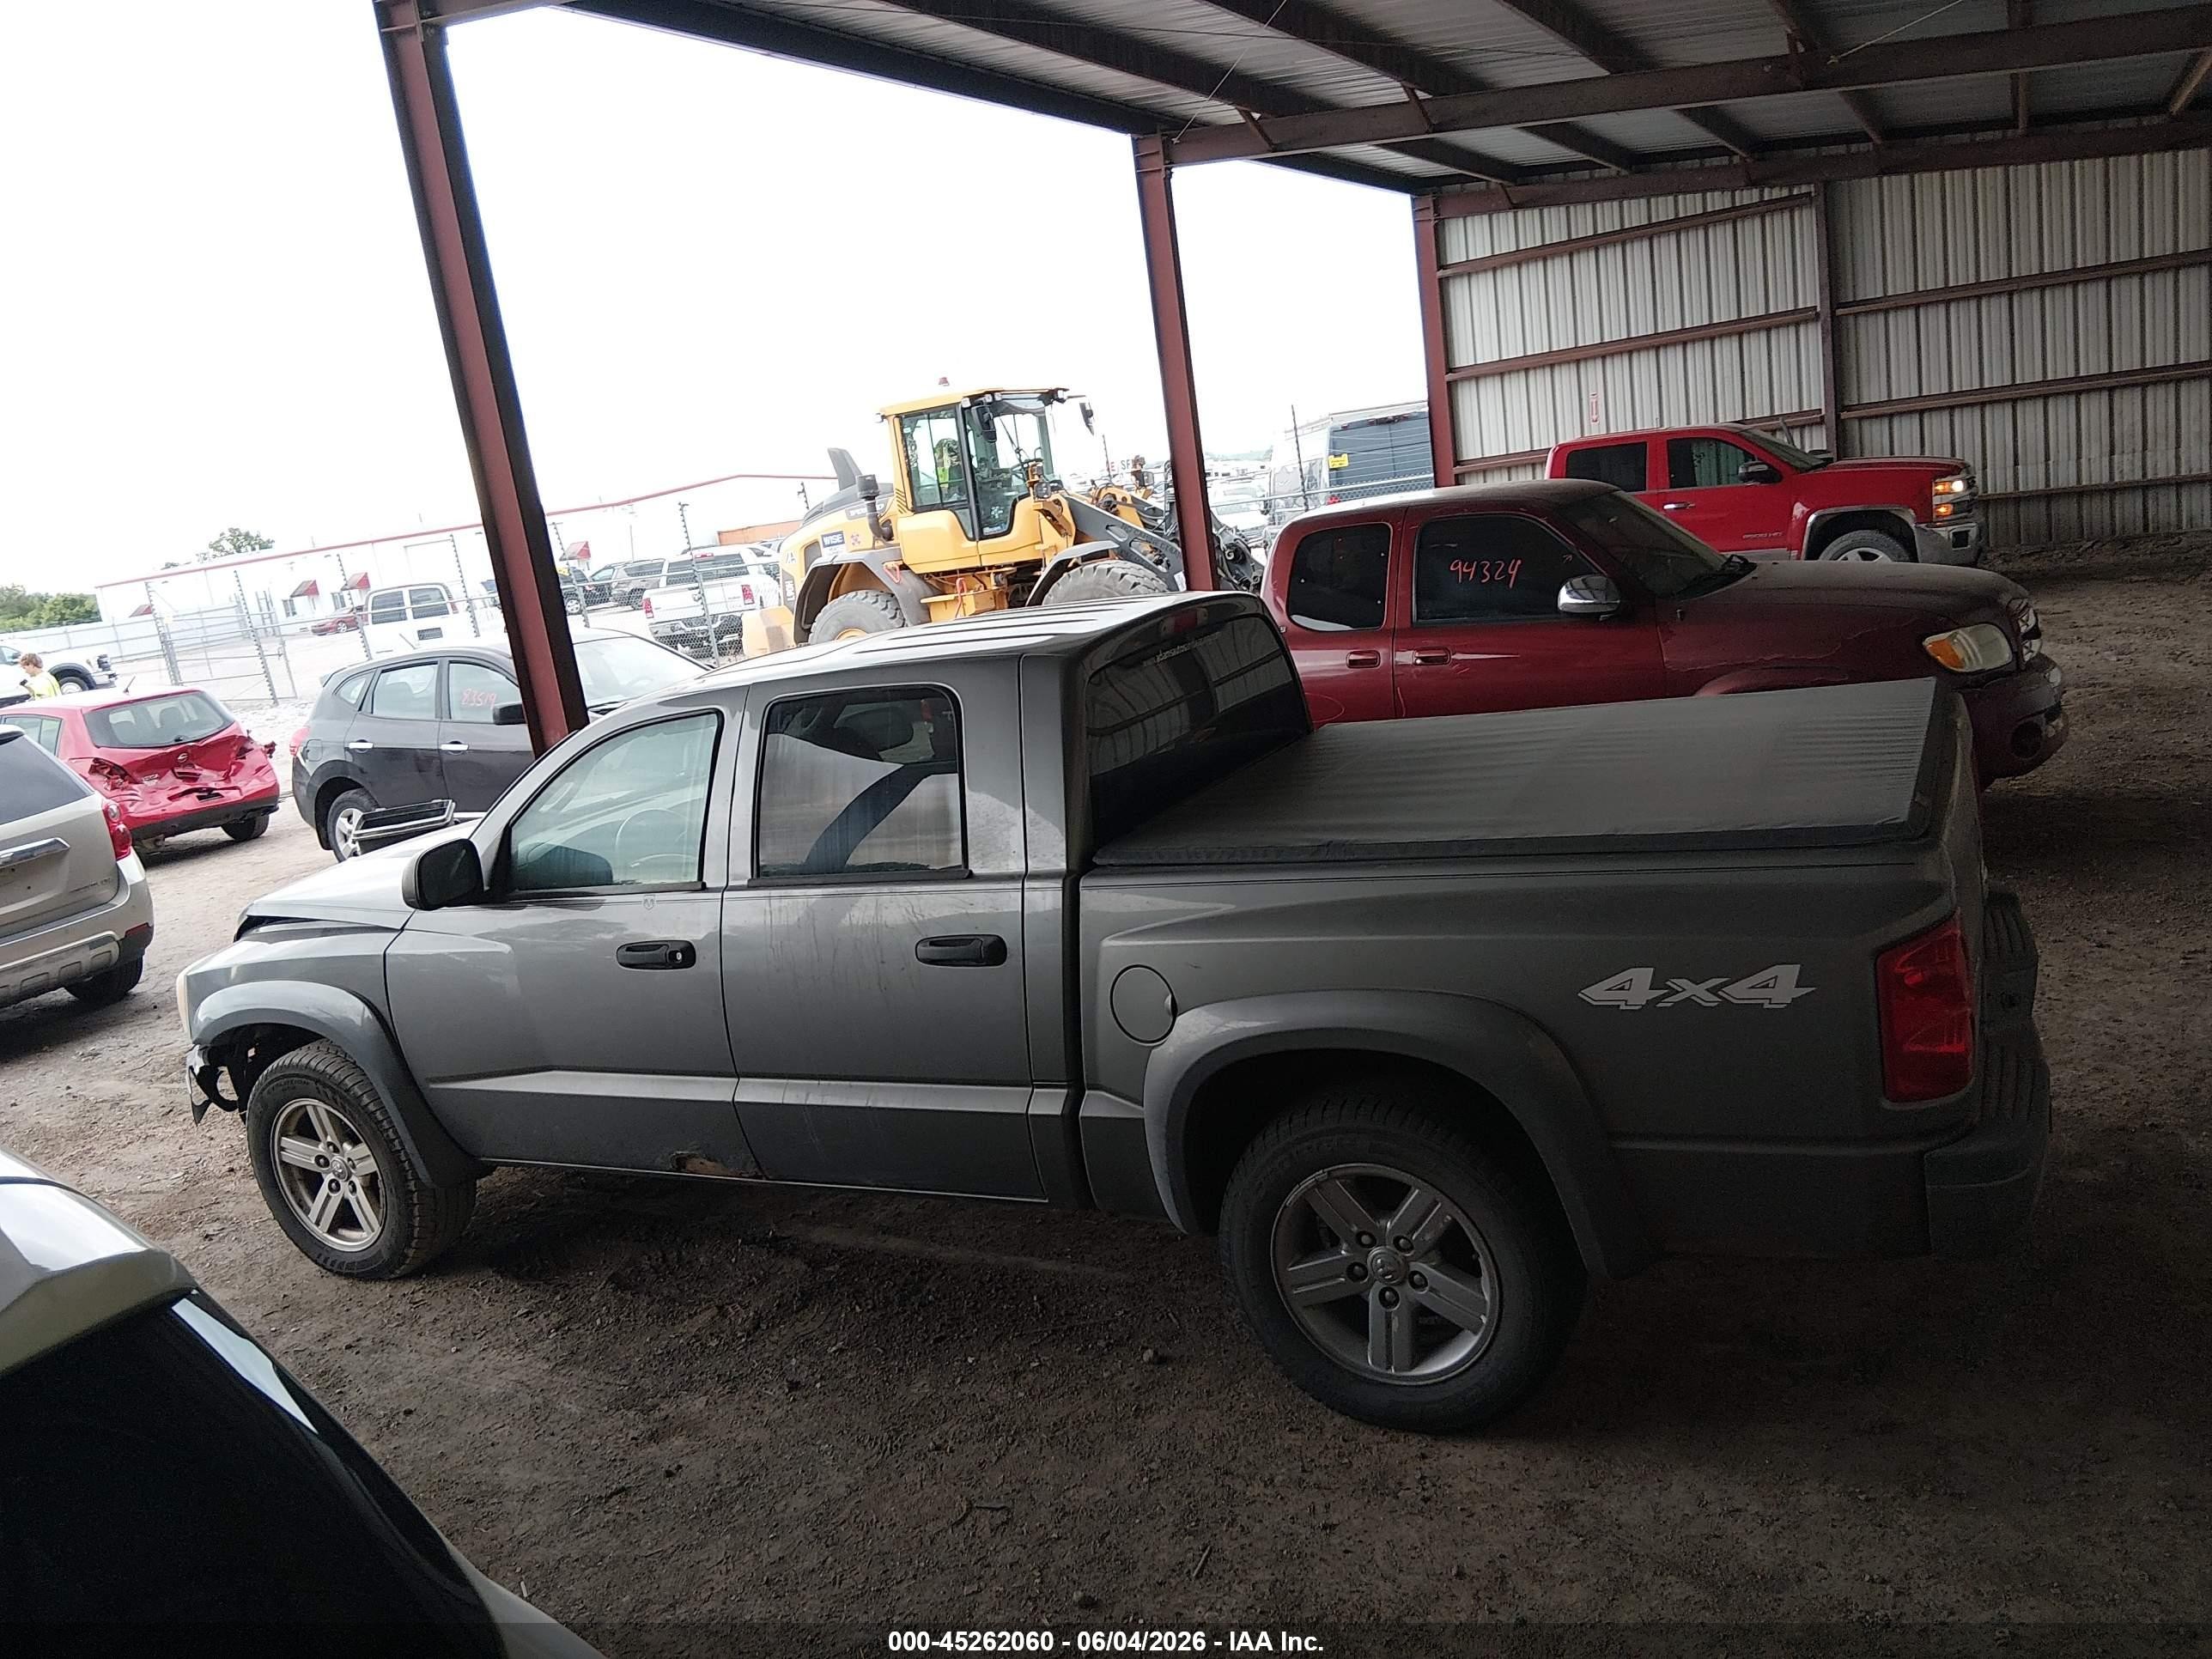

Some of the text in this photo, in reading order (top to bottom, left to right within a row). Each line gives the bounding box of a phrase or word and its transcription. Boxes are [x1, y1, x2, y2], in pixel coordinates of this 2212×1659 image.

[822, 534, 844, 545] WISE
[1449, 558, 1522, 588] 94324
[1577, 963, 1817, 1010] 4x4
